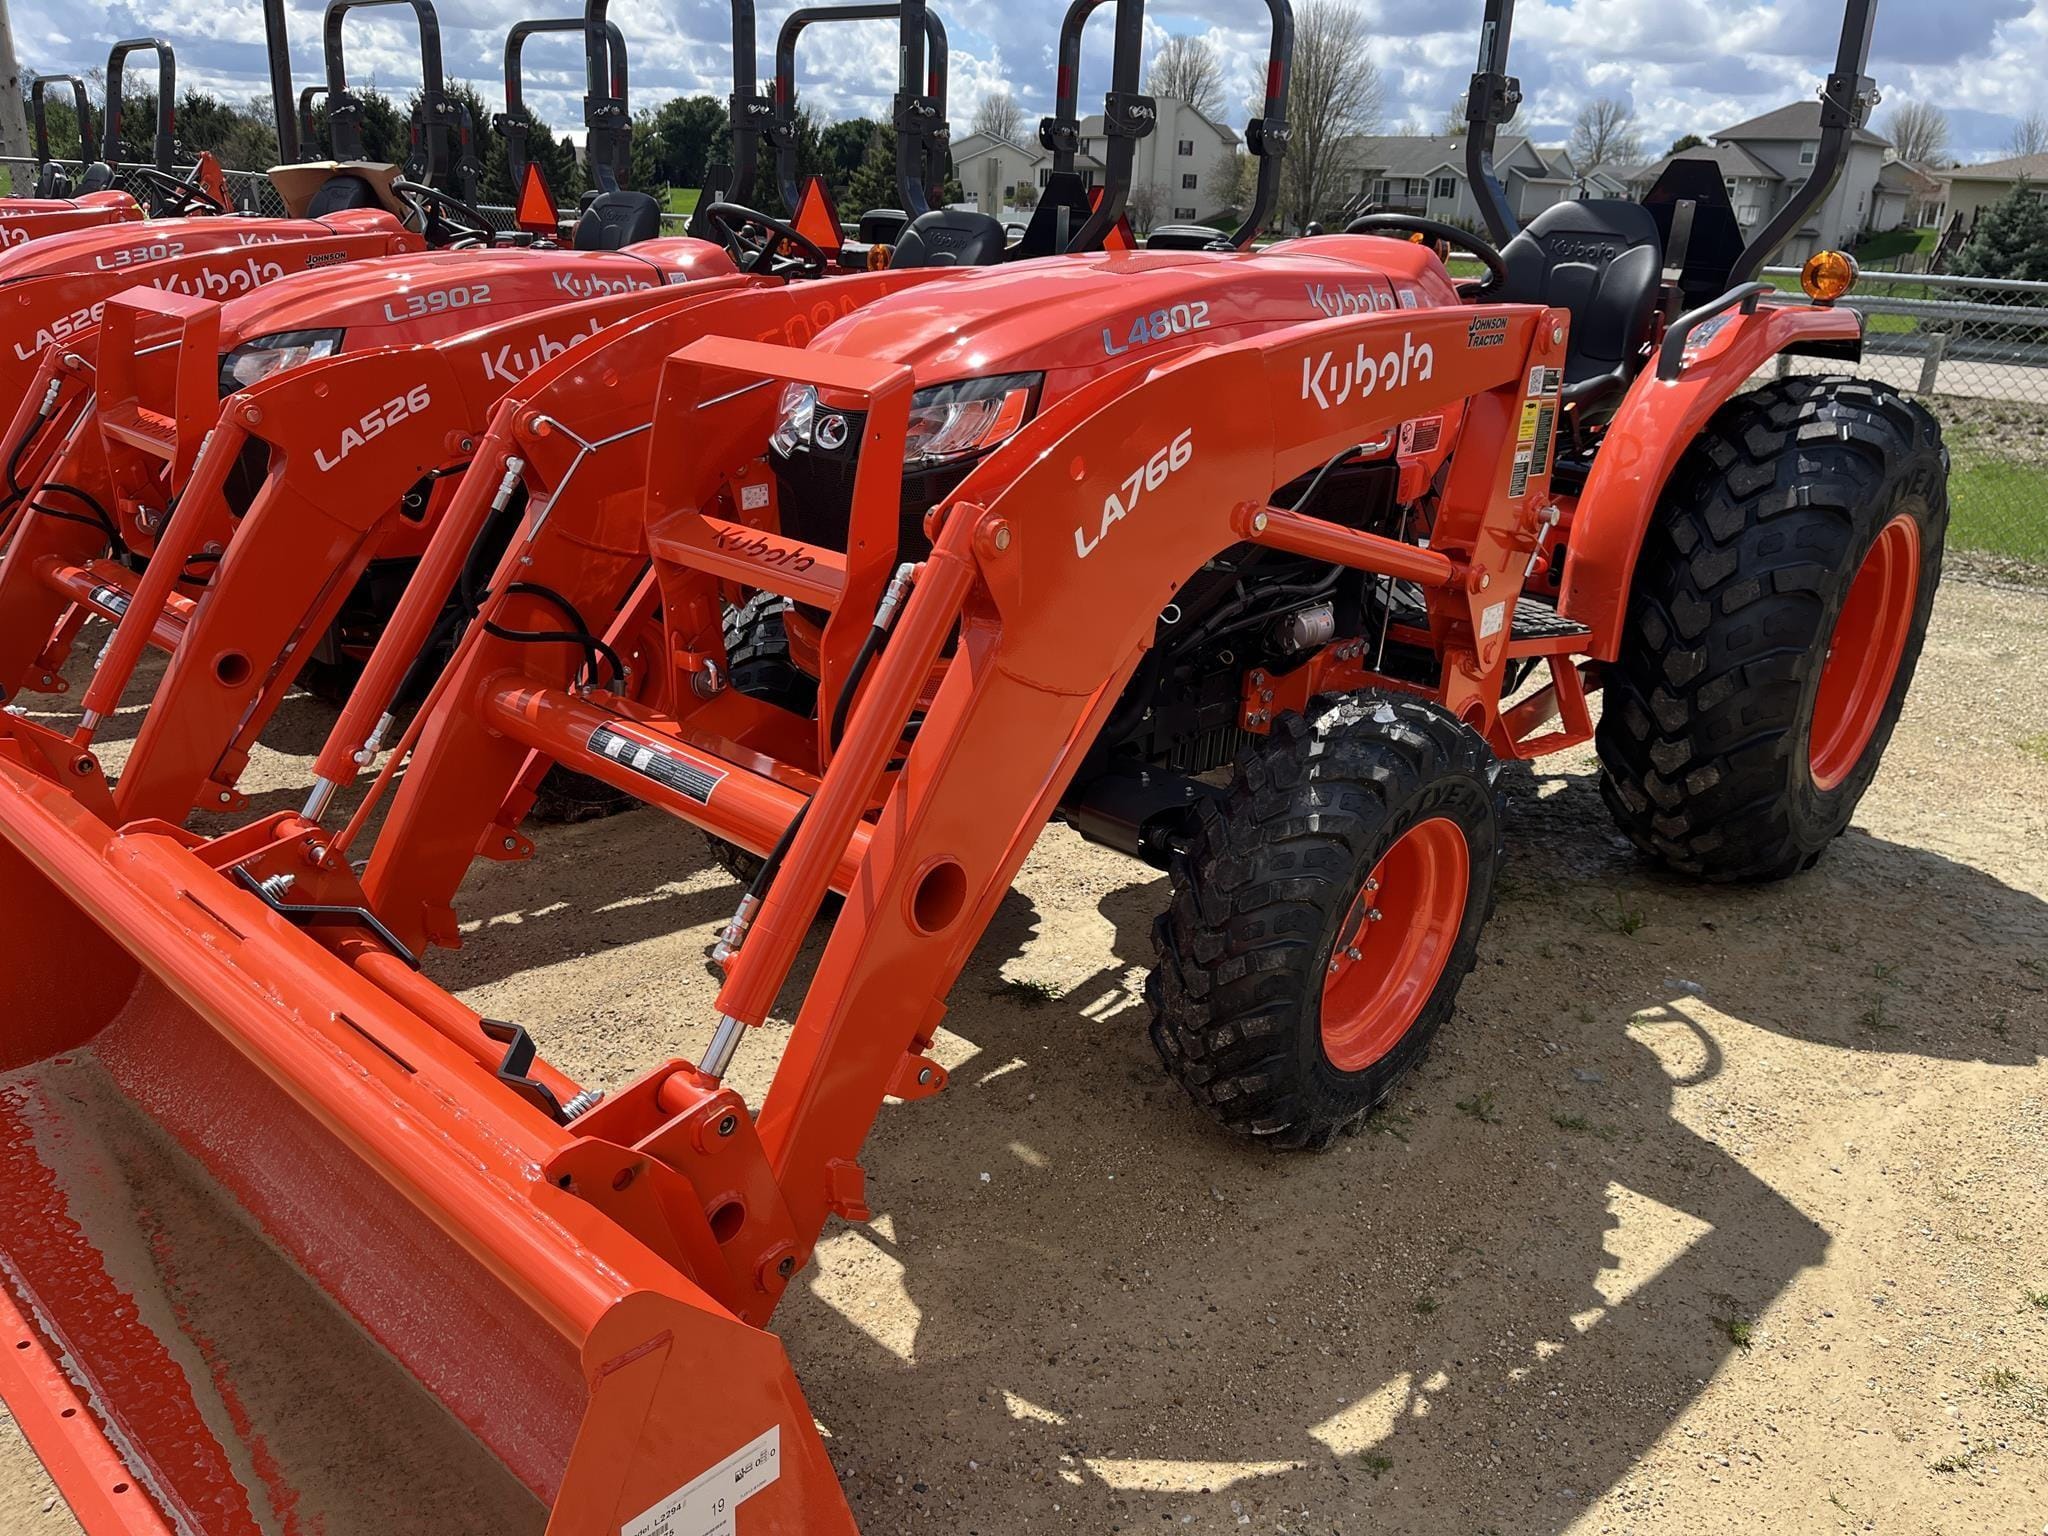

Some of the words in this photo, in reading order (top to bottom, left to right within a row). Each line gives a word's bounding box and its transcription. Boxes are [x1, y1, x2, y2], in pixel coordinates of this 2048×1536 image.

[95, 242, 185, 271] L3302
[305, 252, 347, 265] JOHNSON
[1549, 237, 1618, 261] Kubota
[383, 283, 492, 323] L3902
[1304, 283, 1397, 318] Kubota
[1102, 301, 1210, 358] L4802
[1467, 332, 1505, 349] TRACTOR
[1468, 315, 1508, 332] JOHNSON
[1302, 332, 1434, 411] Kubota
[313, 382, 431, 473] LA526
[1074, 427, 1194, 560] LA766
[711, 524, 817, 574] Kubota
[711, 1498, 725, 1516] 19
